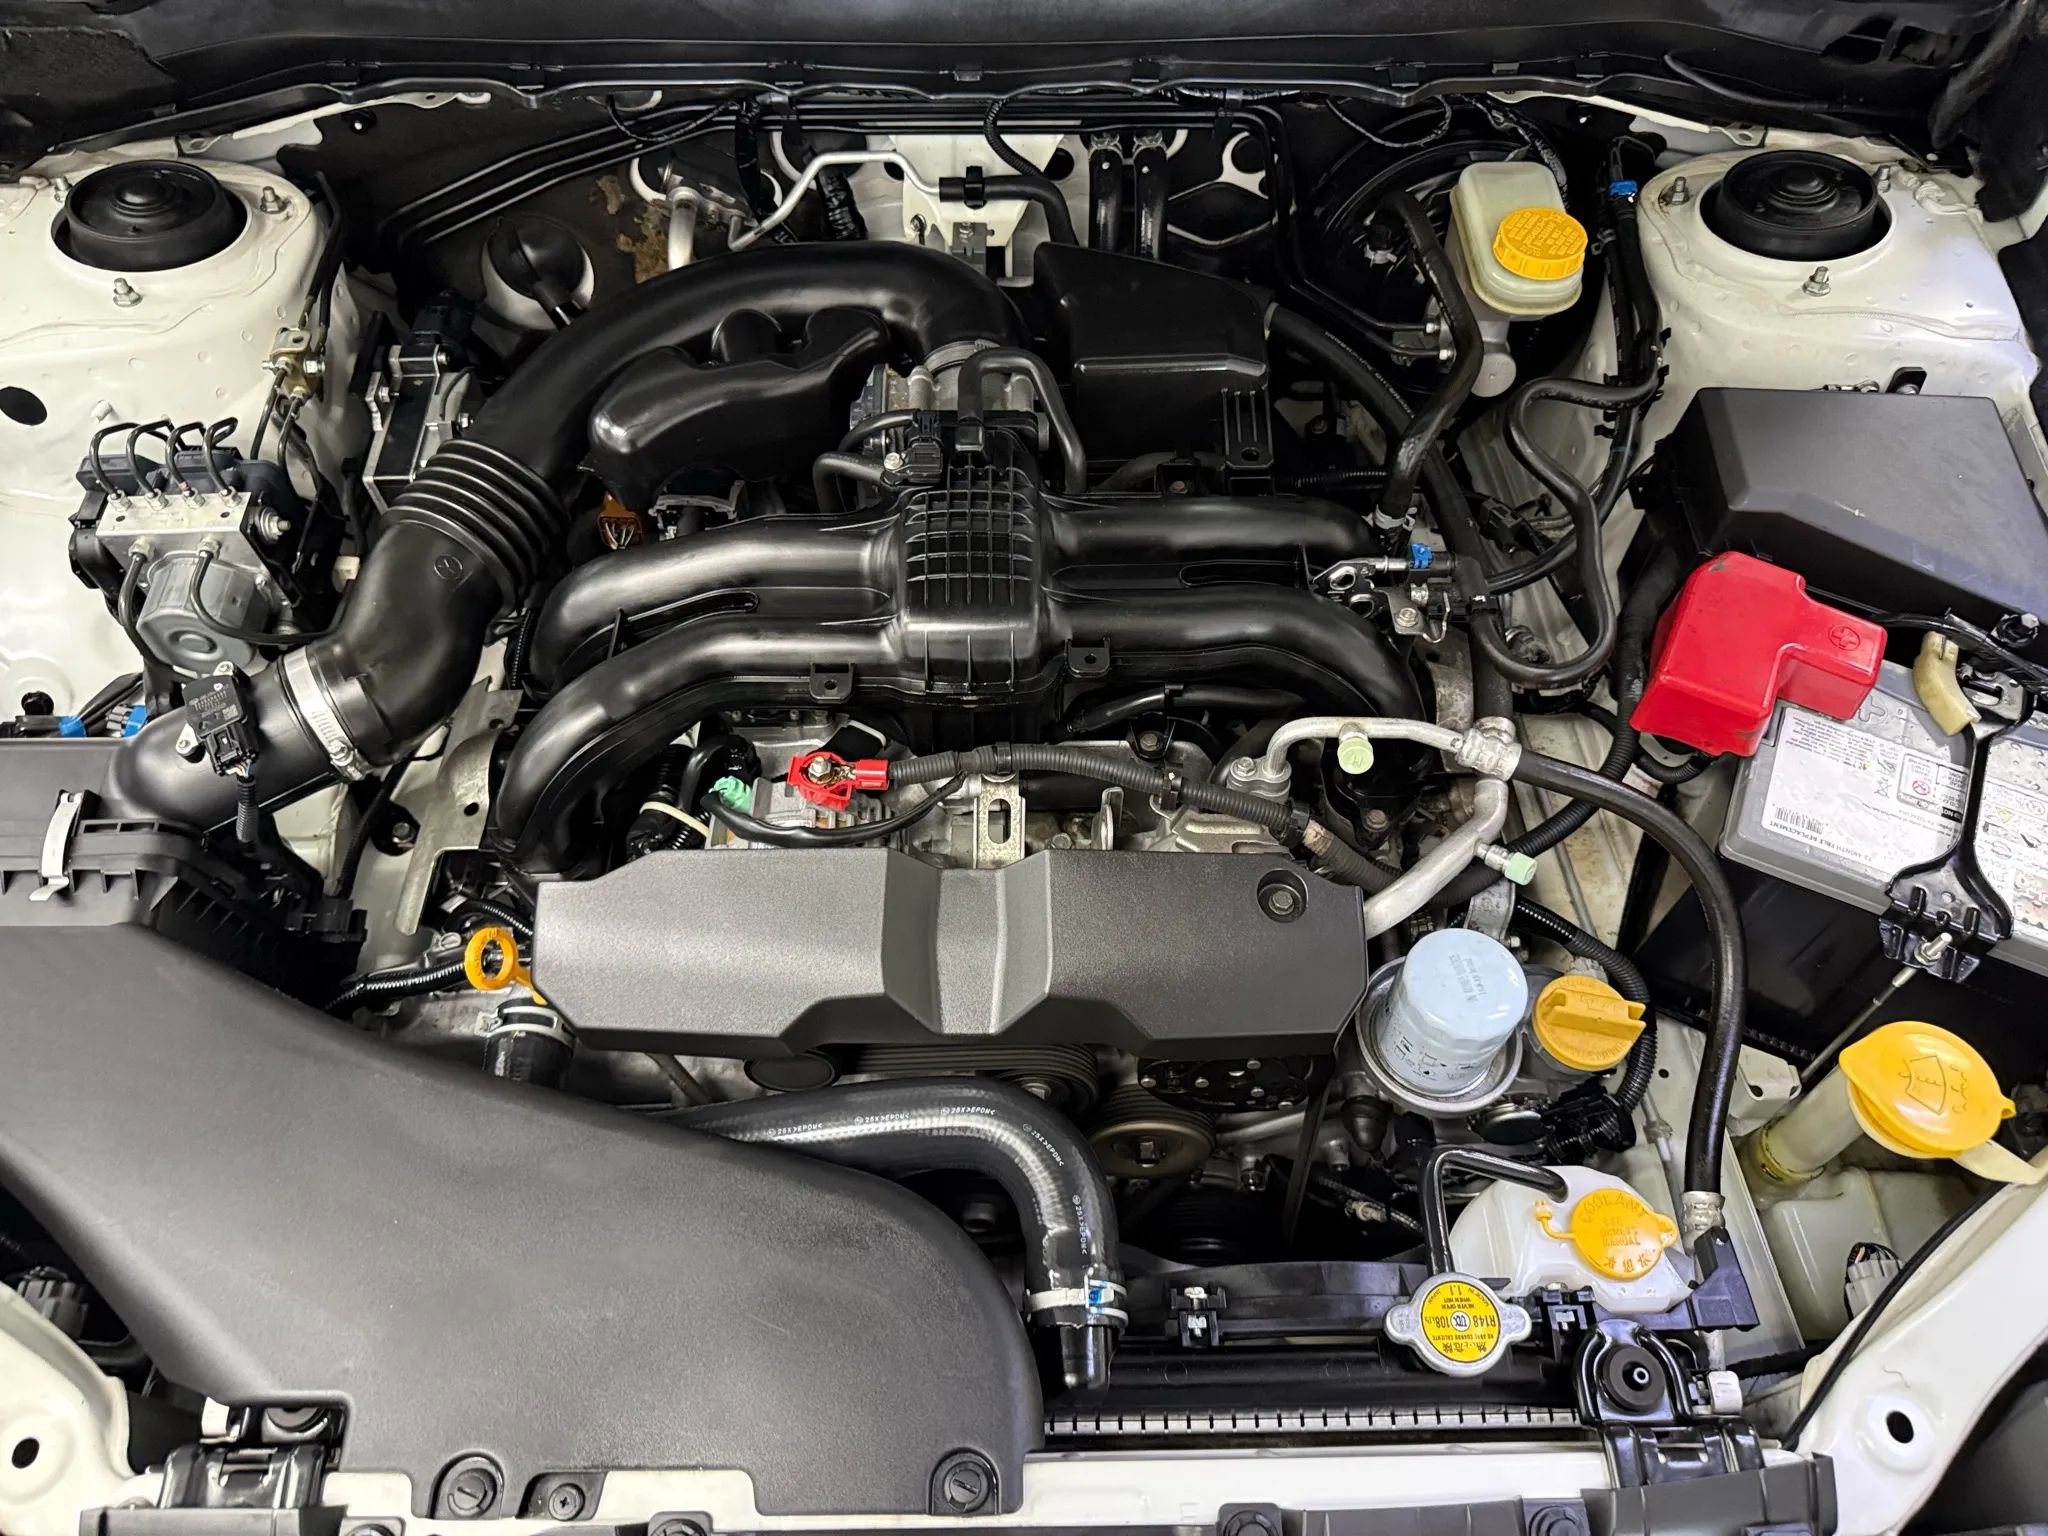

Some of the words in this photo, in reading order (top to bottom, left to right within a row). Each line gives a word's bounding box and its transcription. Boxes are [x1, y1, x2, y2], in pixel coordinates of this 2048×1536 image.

[1769, 820, 1818, 841] REPLACEMENT
[1427, 1288, 1442, 1304] JAPAN
[1449, 1285, 1462, 1296] 1.1
[1472, 1315, 1497, 1328] R148
